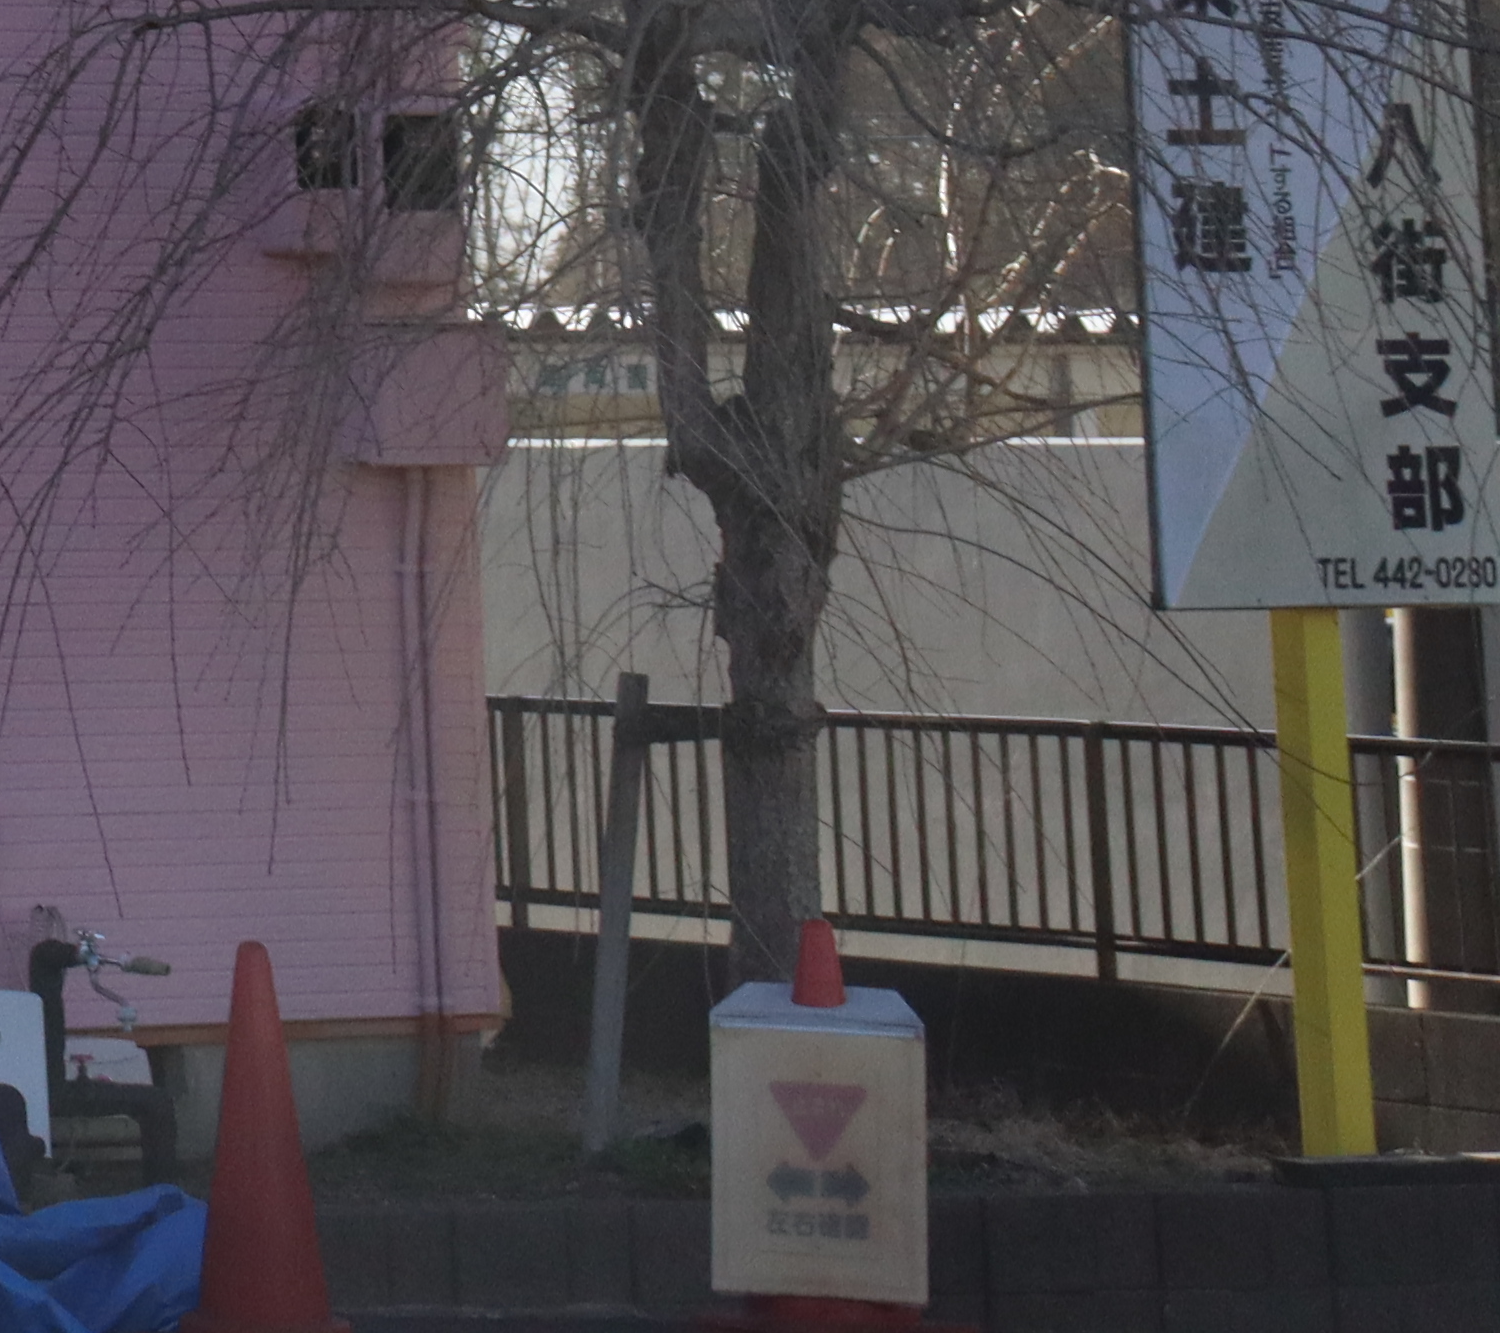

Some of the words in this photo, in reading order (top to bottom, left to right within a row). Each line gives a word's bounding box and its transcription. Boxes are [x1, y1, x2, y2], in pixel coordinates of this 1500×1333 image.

[1367, 102, 1466, 532] 八街支部
[1316, 556, 1365, 590] TEL
[1372, 555, 1498, 590] 442-0280
